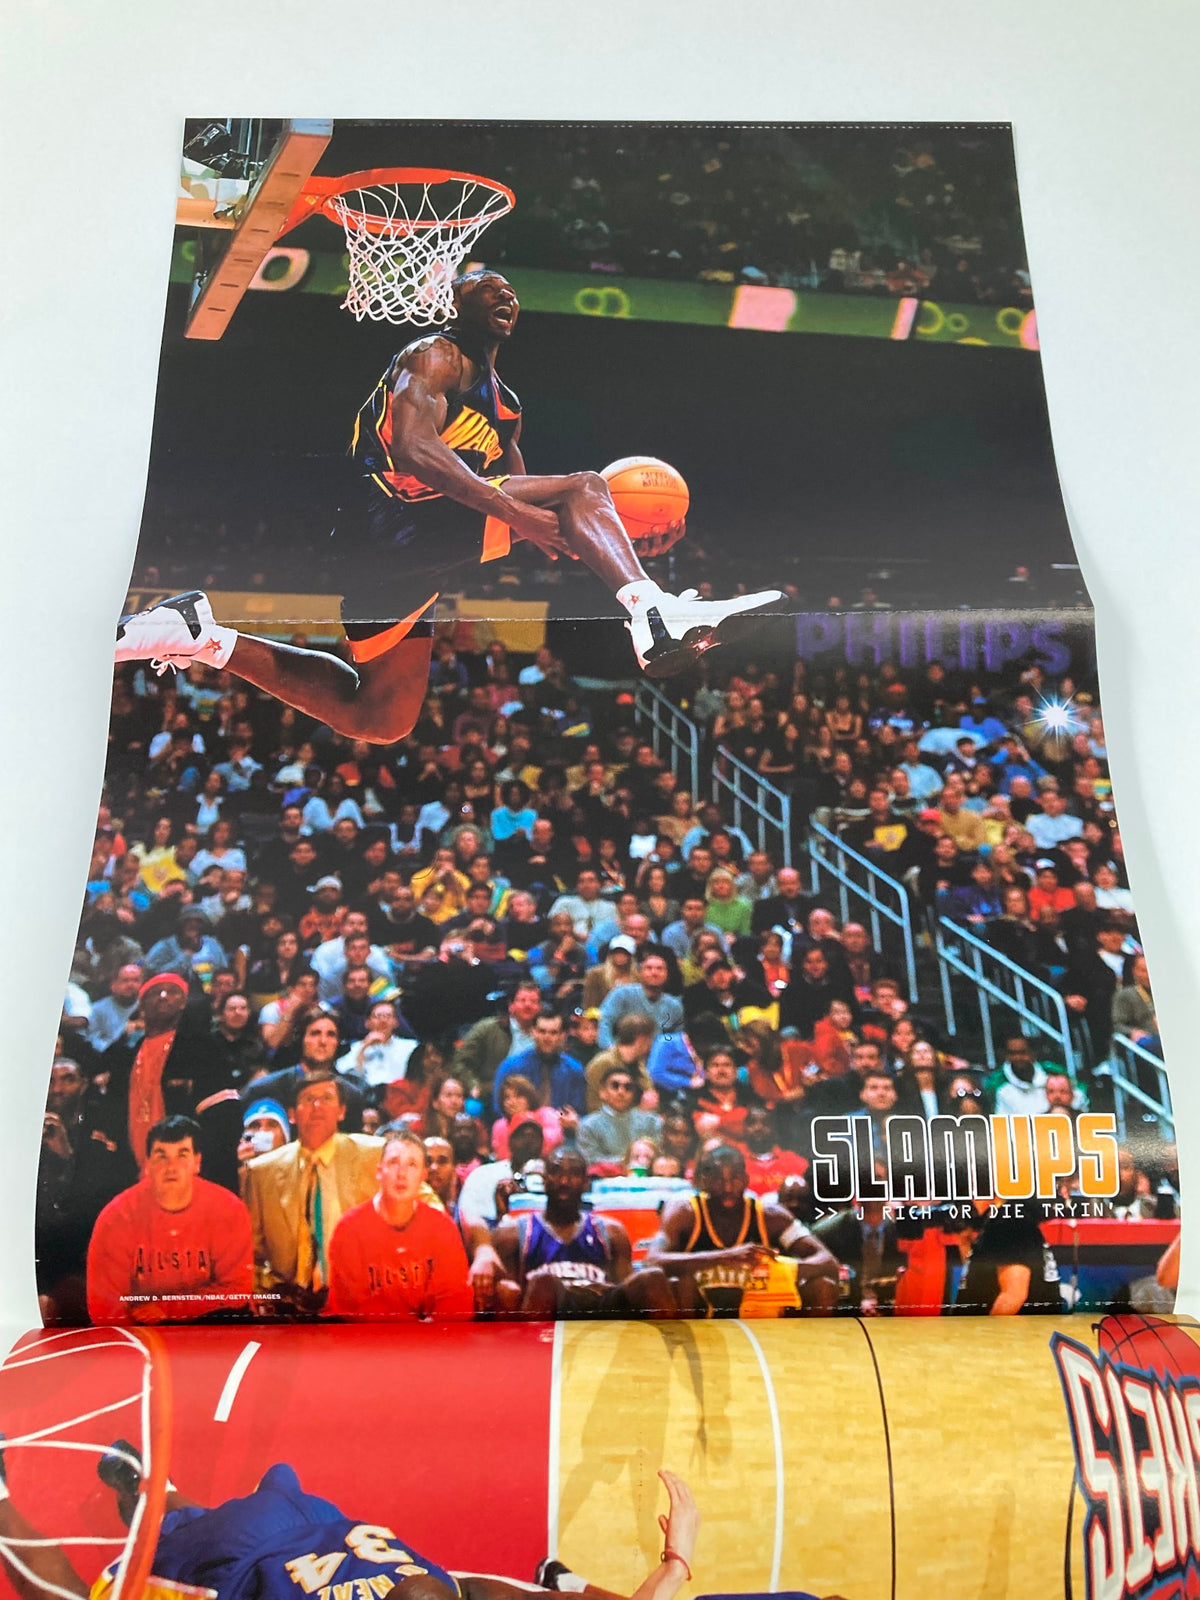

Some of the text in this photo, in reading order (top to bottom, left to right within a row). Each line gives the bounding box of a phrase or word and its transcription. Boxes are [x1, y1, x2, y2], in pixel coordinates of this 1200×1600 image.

[796, 611, 1071, 674] PHILIPS
[856, 1205, 865, 1221] J
[882, 1204, 933, 1220] RICH
[949, 1204, 972, 1219] OR
[989, 1203, 1025, 1219] DIE
[1042, 1202, 1115, 1218] TRYIN'
[162, 1293, 251, 1301] BERNSTEIN/NBAE/GETTY
[284, 1524, 415, 1595] 34
